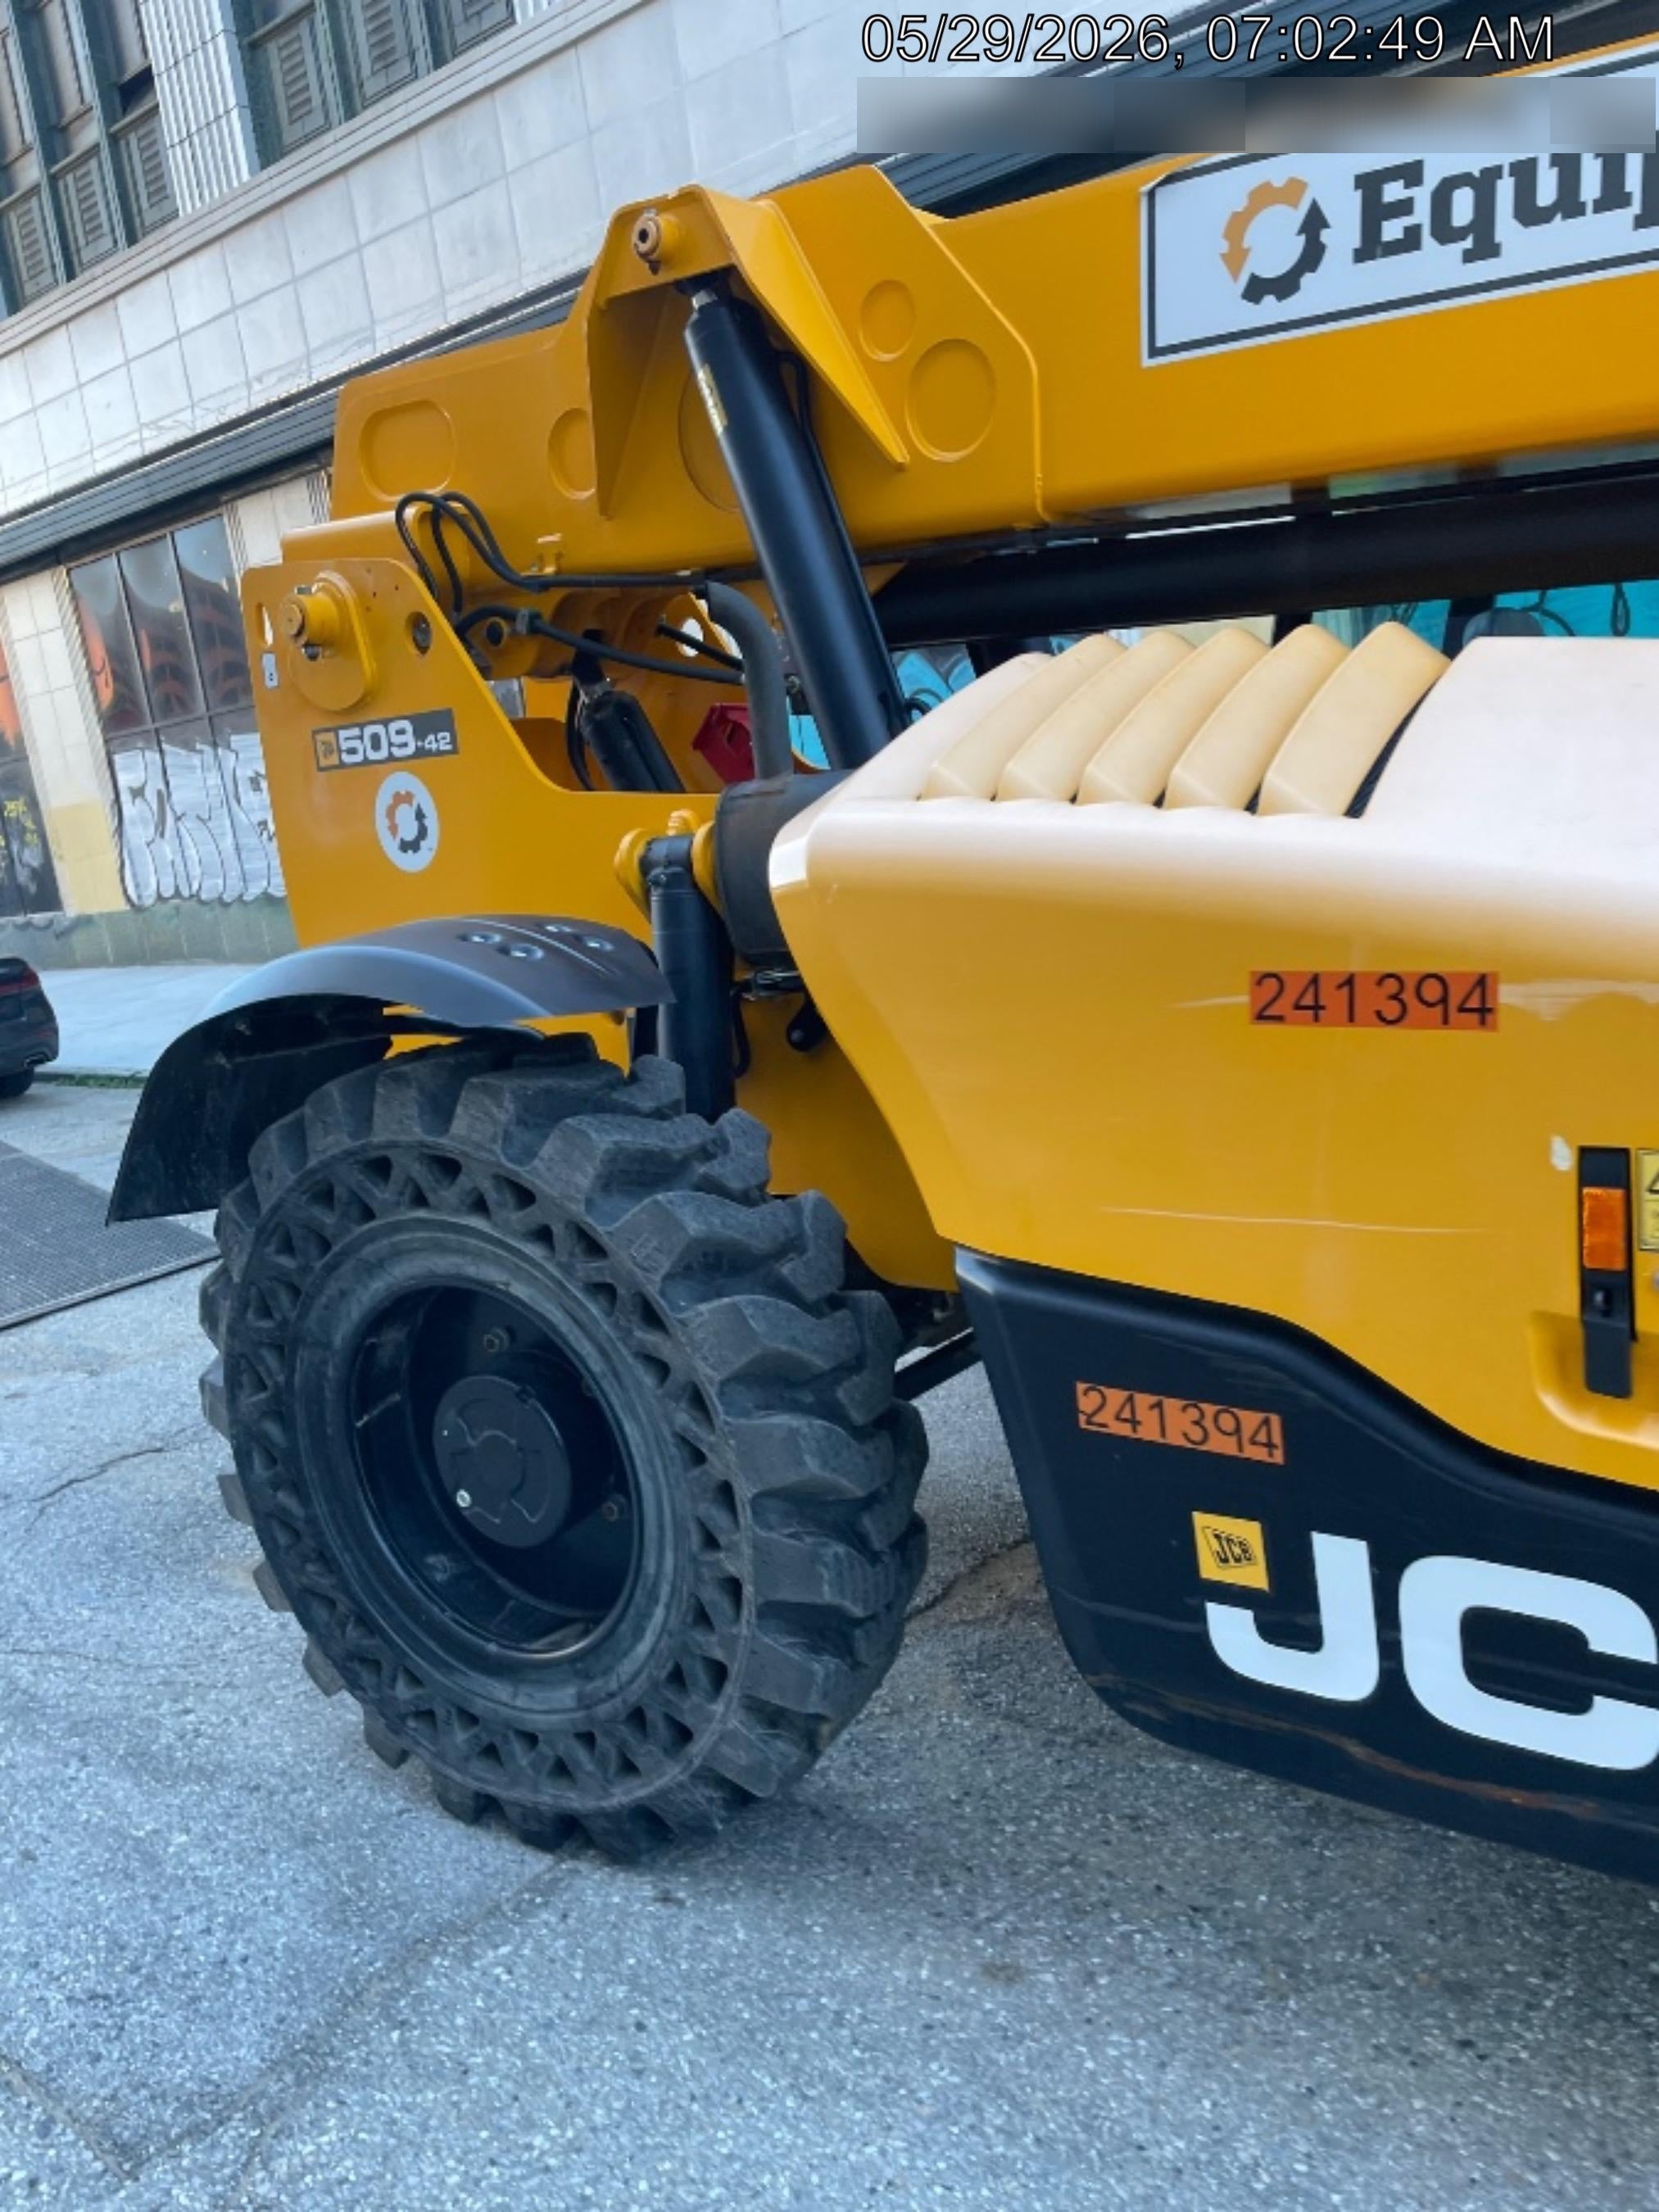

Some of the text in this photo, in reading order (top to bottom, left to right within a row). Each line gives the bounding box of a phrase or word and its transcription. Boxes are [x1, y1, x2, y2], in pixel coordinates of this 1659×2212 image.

[1253, 972, 1494, 1026] 241394
[1080, 1386, 1279, 1458] 241394
[1213, 1532, 1253, 1563] JCB
